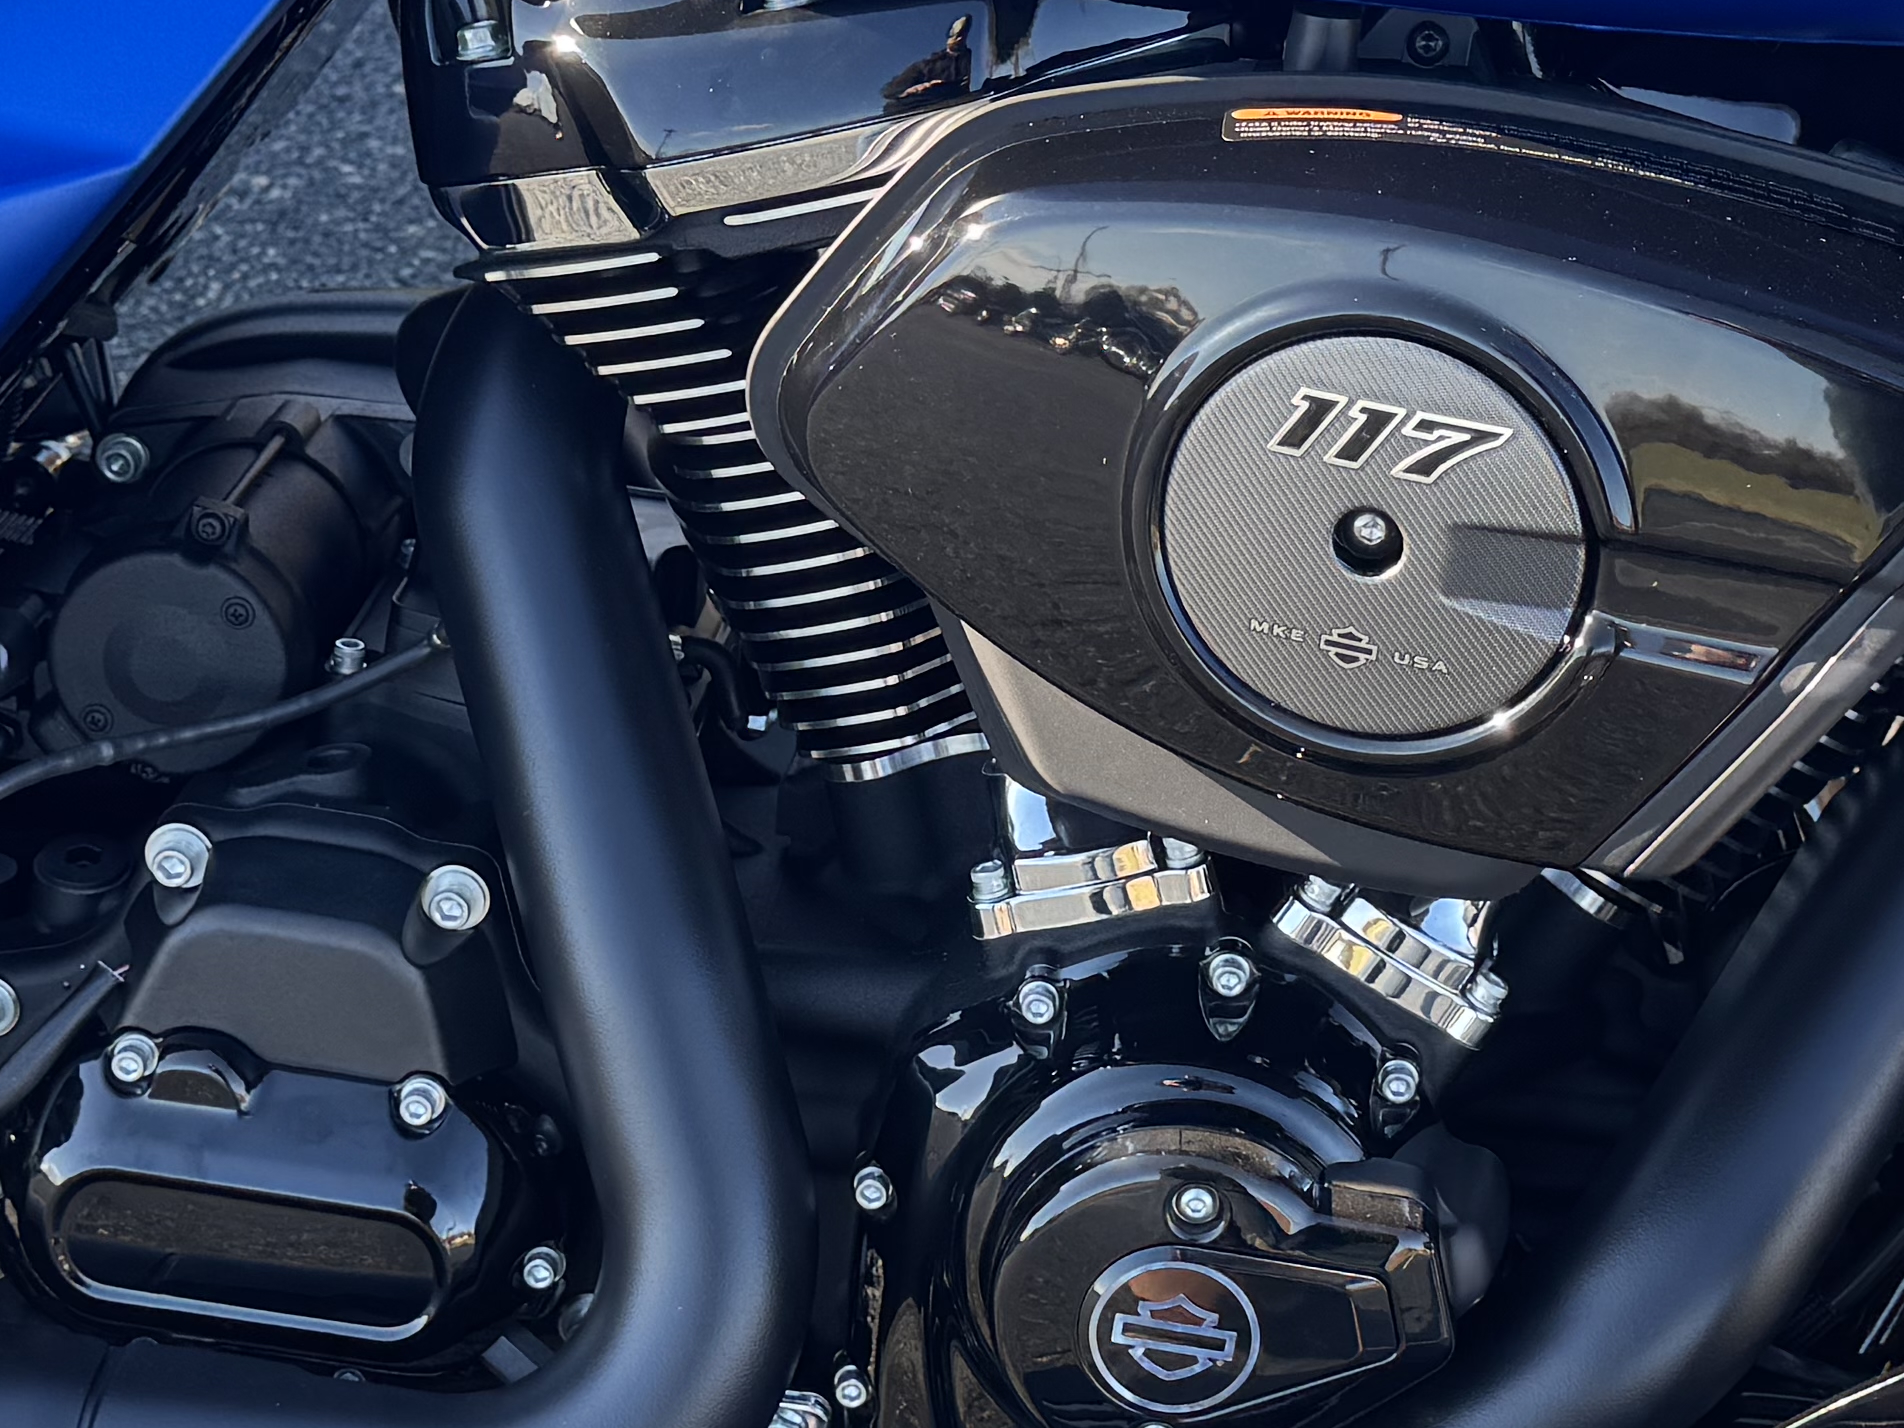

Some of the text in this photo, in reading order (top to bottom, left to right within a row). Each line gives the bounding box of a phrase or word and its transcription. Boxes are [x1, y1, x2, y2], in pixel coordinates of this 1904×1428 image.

[1284, 109, 1372, 119] WARNING
[1267, 387, 1514, 484] 117
[1249, 618, 1449, 675] MKE USA
